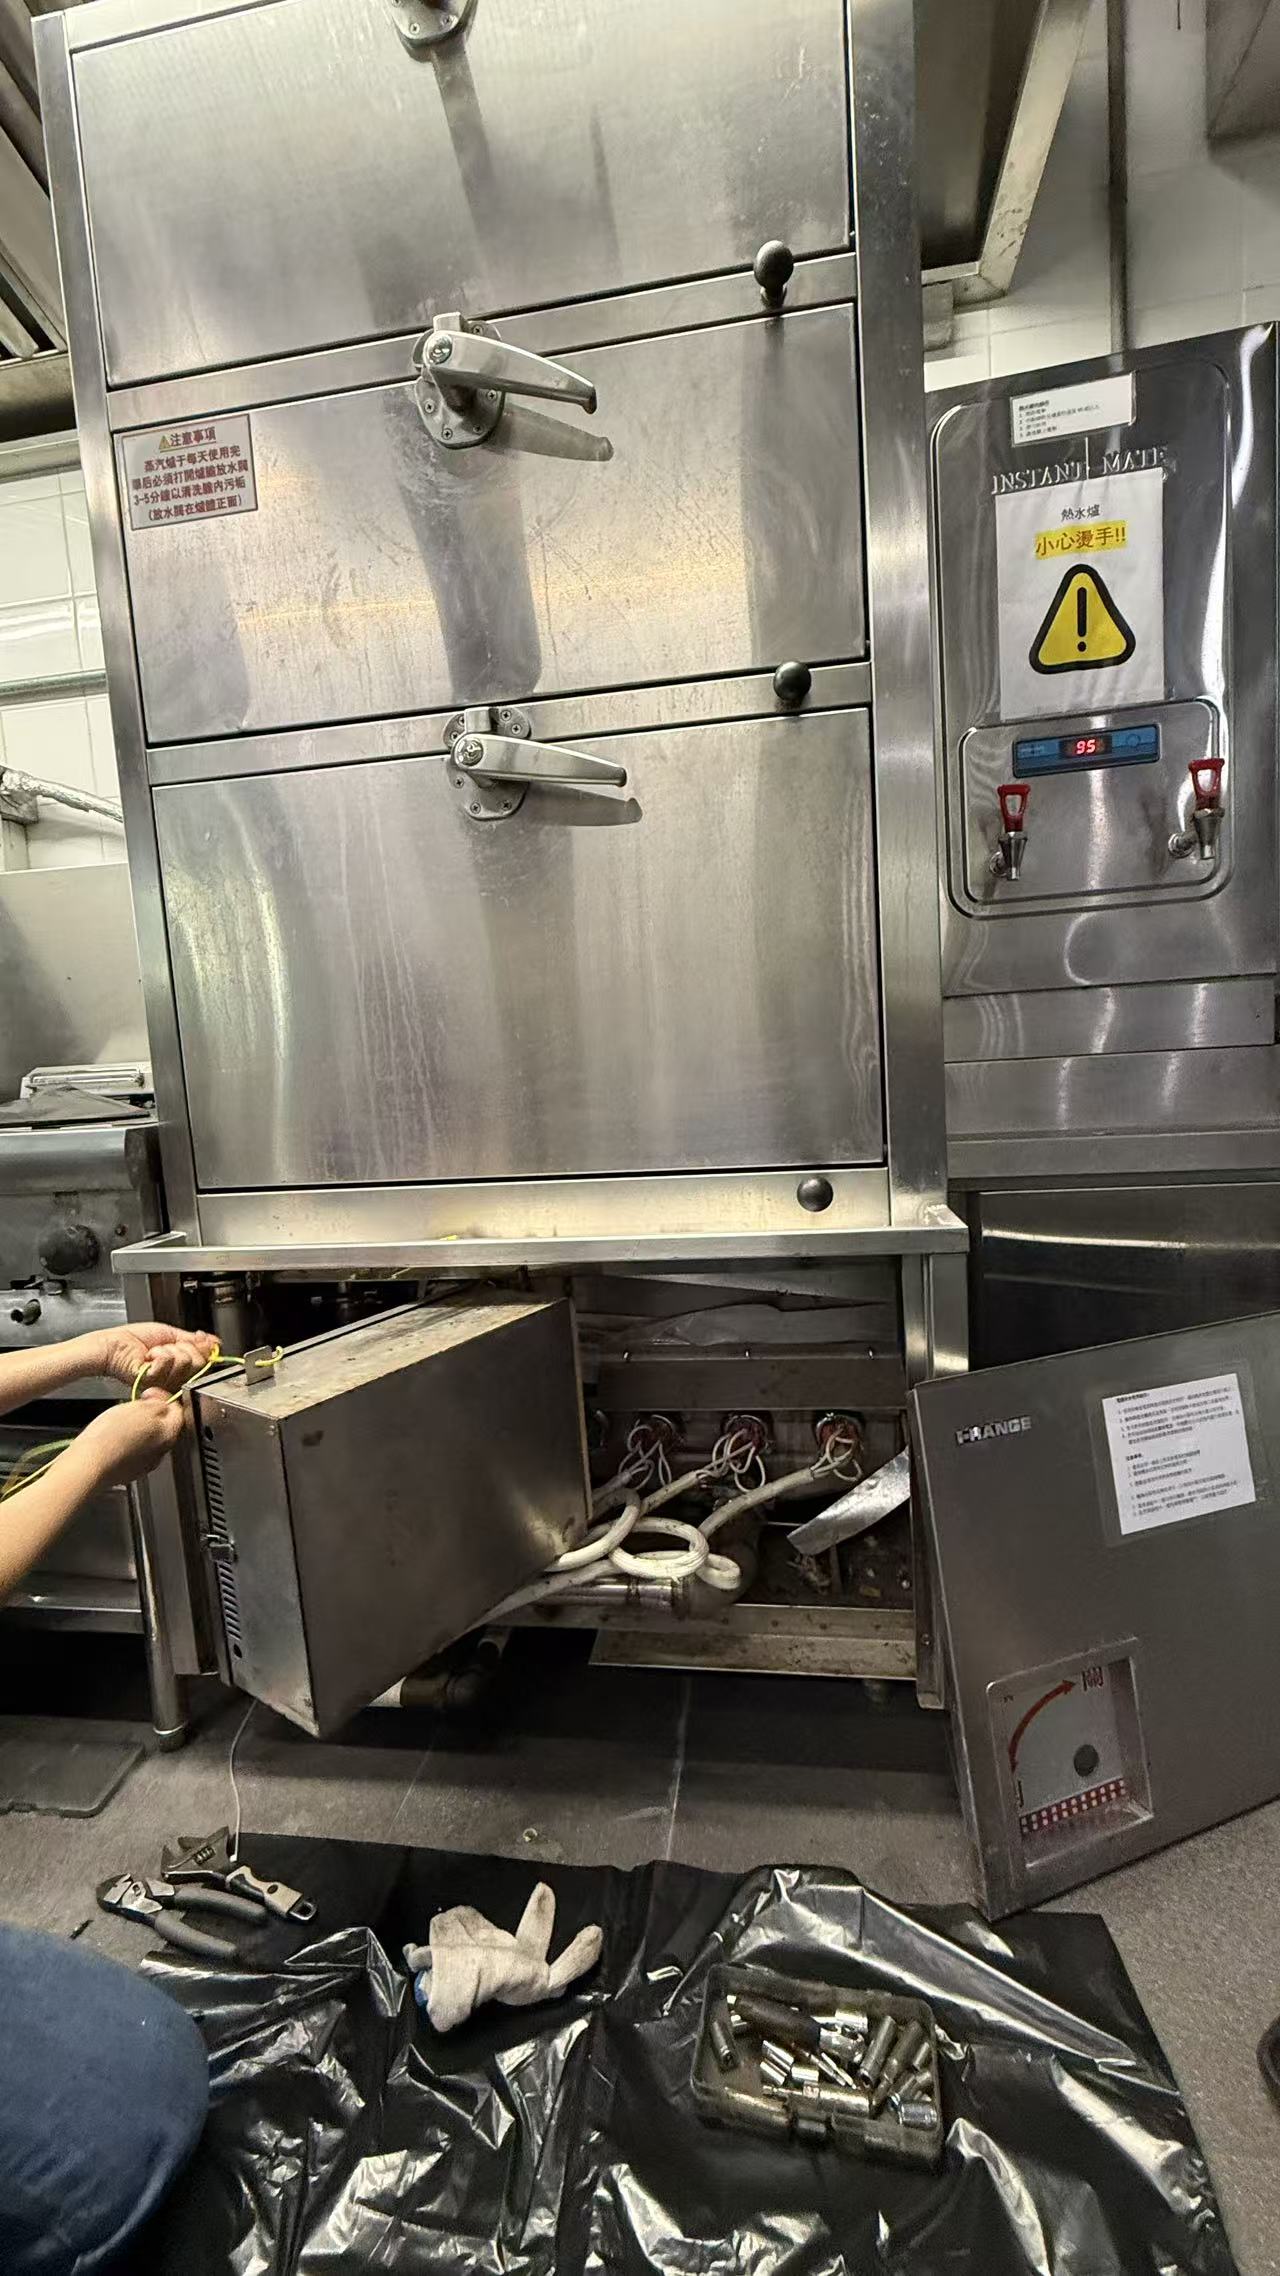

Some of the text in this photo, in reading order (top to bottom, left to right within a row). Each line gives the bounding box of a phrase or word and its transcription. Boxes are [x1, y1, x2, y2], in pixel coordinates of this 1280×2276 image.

[169, 427, 216, 447] 注意事項
[1061, 504, 1100, 522] 熱水爐
[1035, 526, 1126, 556] 小心燙手!!
[1075, 739, 1096, 755] 95
